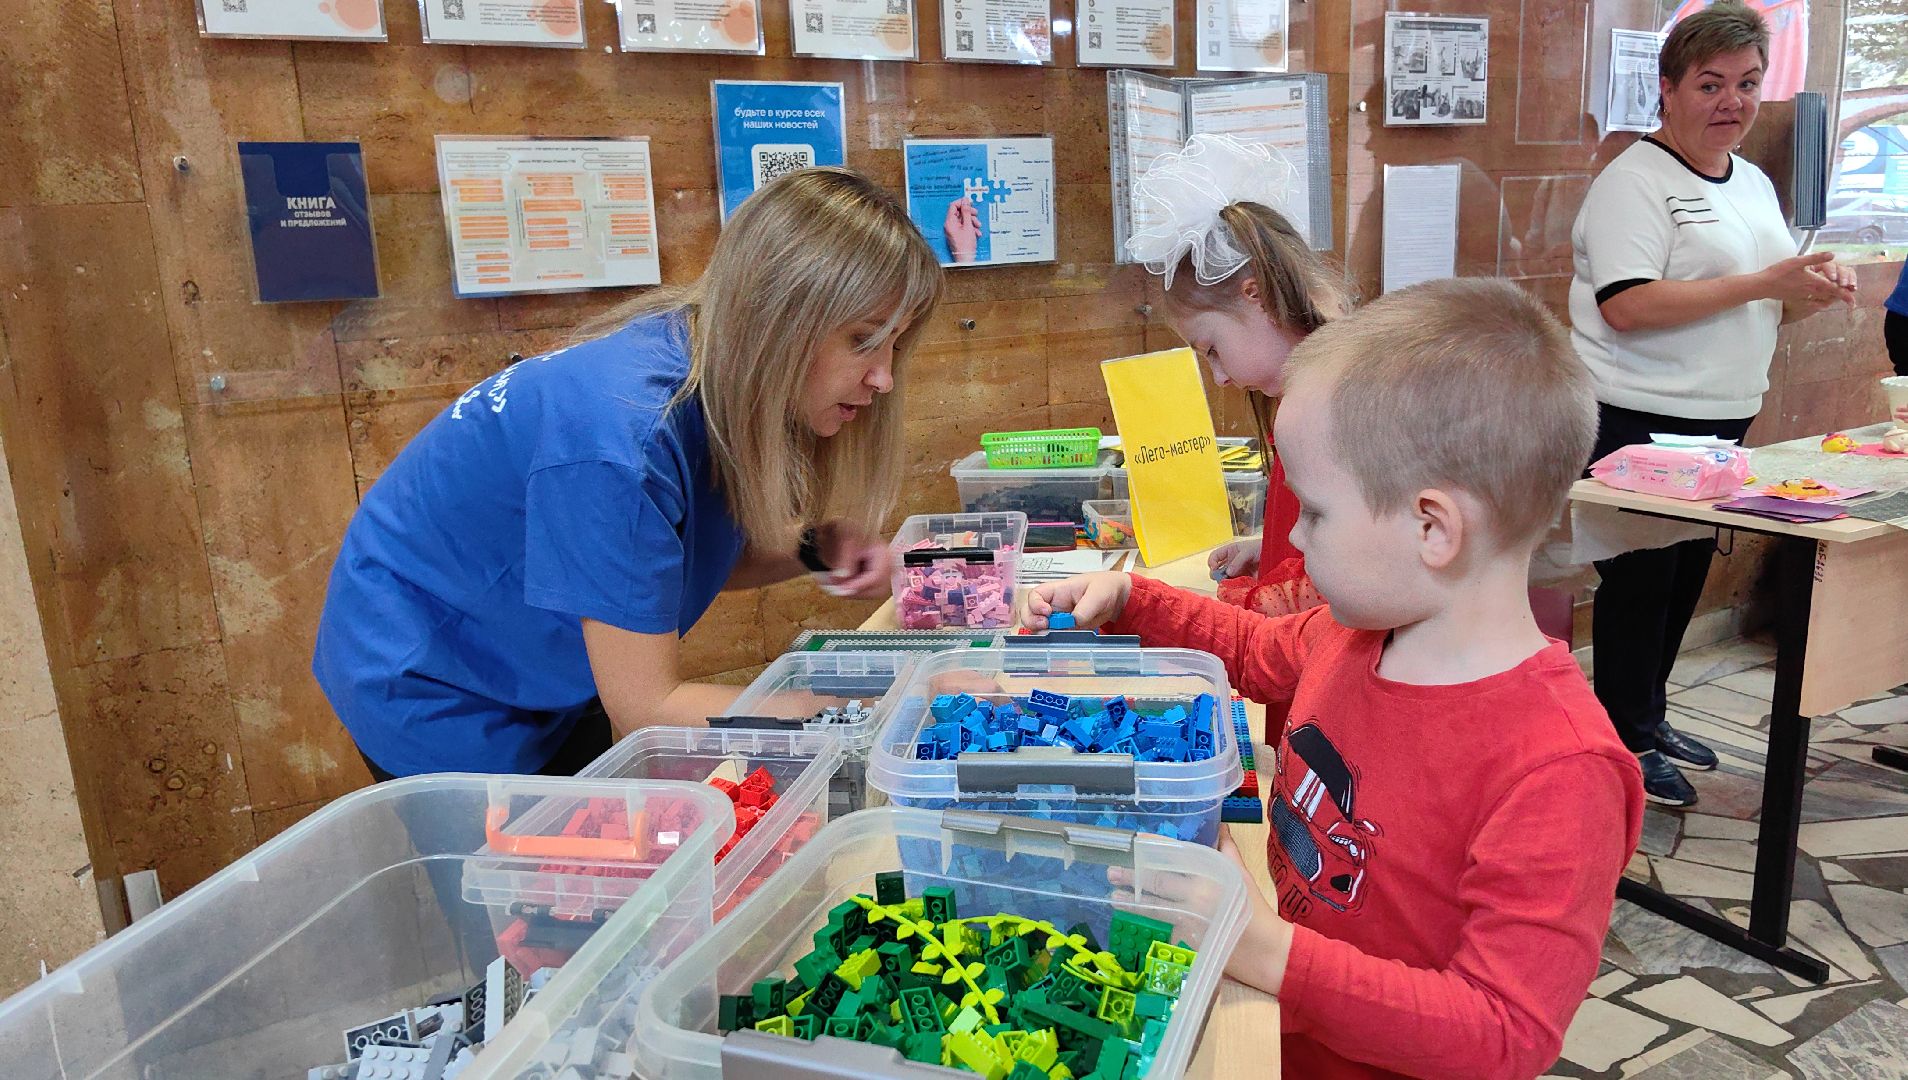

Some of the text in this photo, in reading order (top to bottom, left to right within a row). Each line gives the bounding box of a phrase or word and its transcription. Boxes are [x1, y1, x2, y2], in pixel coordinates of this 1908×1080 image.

[734, 107, 766, 118] будьте
[775, 109, 803, 118] курсе
[804, 109, 826, 117] всех
[743, 120, 819, 129] наших новостей
[287, 196, 337, 210] КНИГА
[280, 217, 347, 228] И ПРЕДЛОЖЕНИЙ
[1134, 436, 1211, 464] «Лего-мастер»
[1280, 883, 1314, 920] UP
